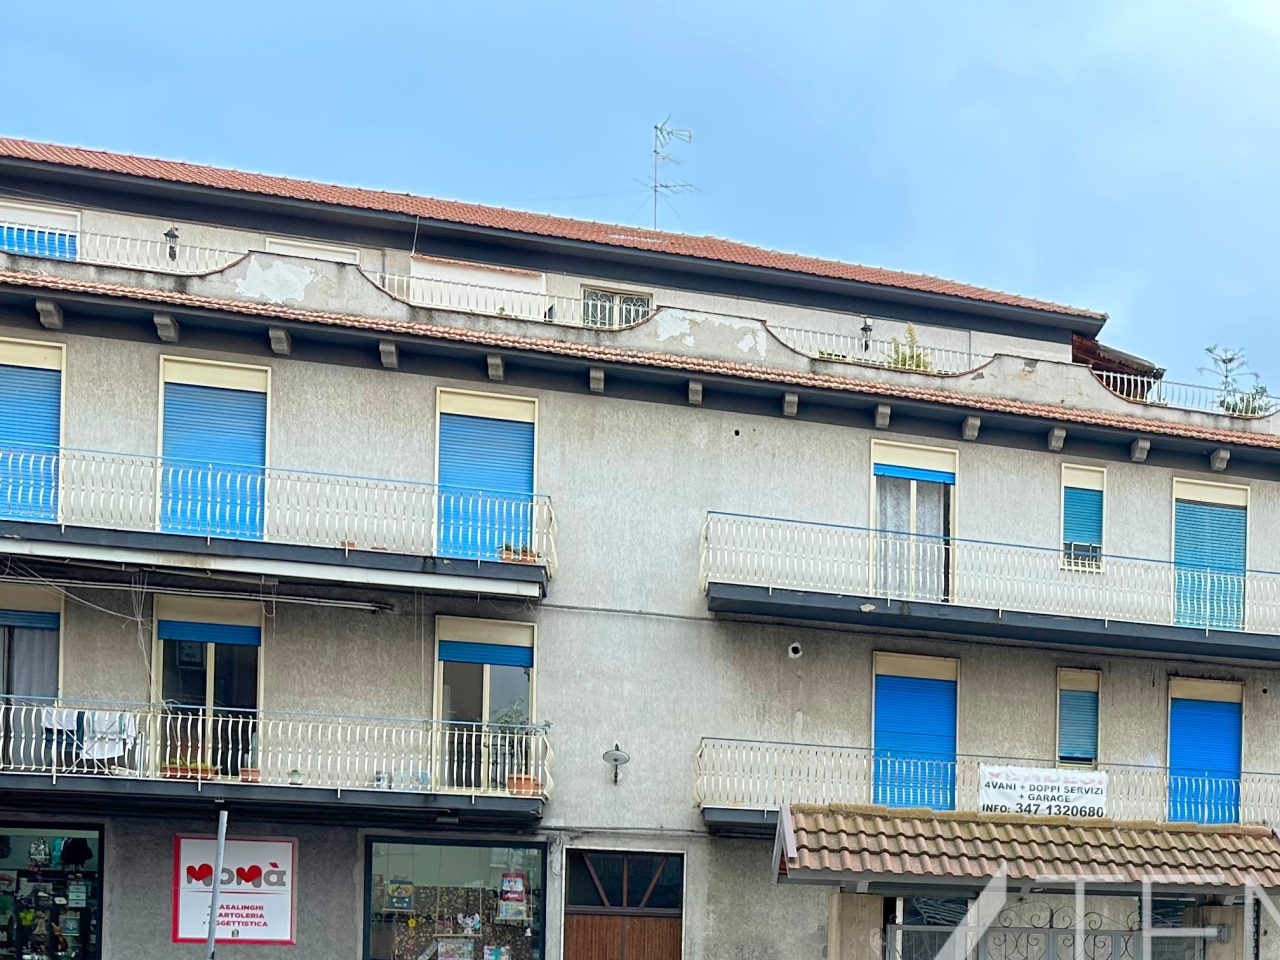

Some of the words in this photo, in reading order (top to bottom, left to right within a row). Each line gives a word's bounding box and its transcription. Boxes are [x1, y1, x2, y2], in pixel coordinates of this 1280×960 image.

[984, 781, 1017, 791] 4VANI
[1029, 784, 1060, 793] DOPPI
[1064, 786, 1104, 795] SERVIZI
[1028, 793, 1071, 803] GARAGE
[982, 803, 1011, 813] INFO:
[1015, 802, 1041, 815] 347
[1045, 803, 1104, 818] 1320680
